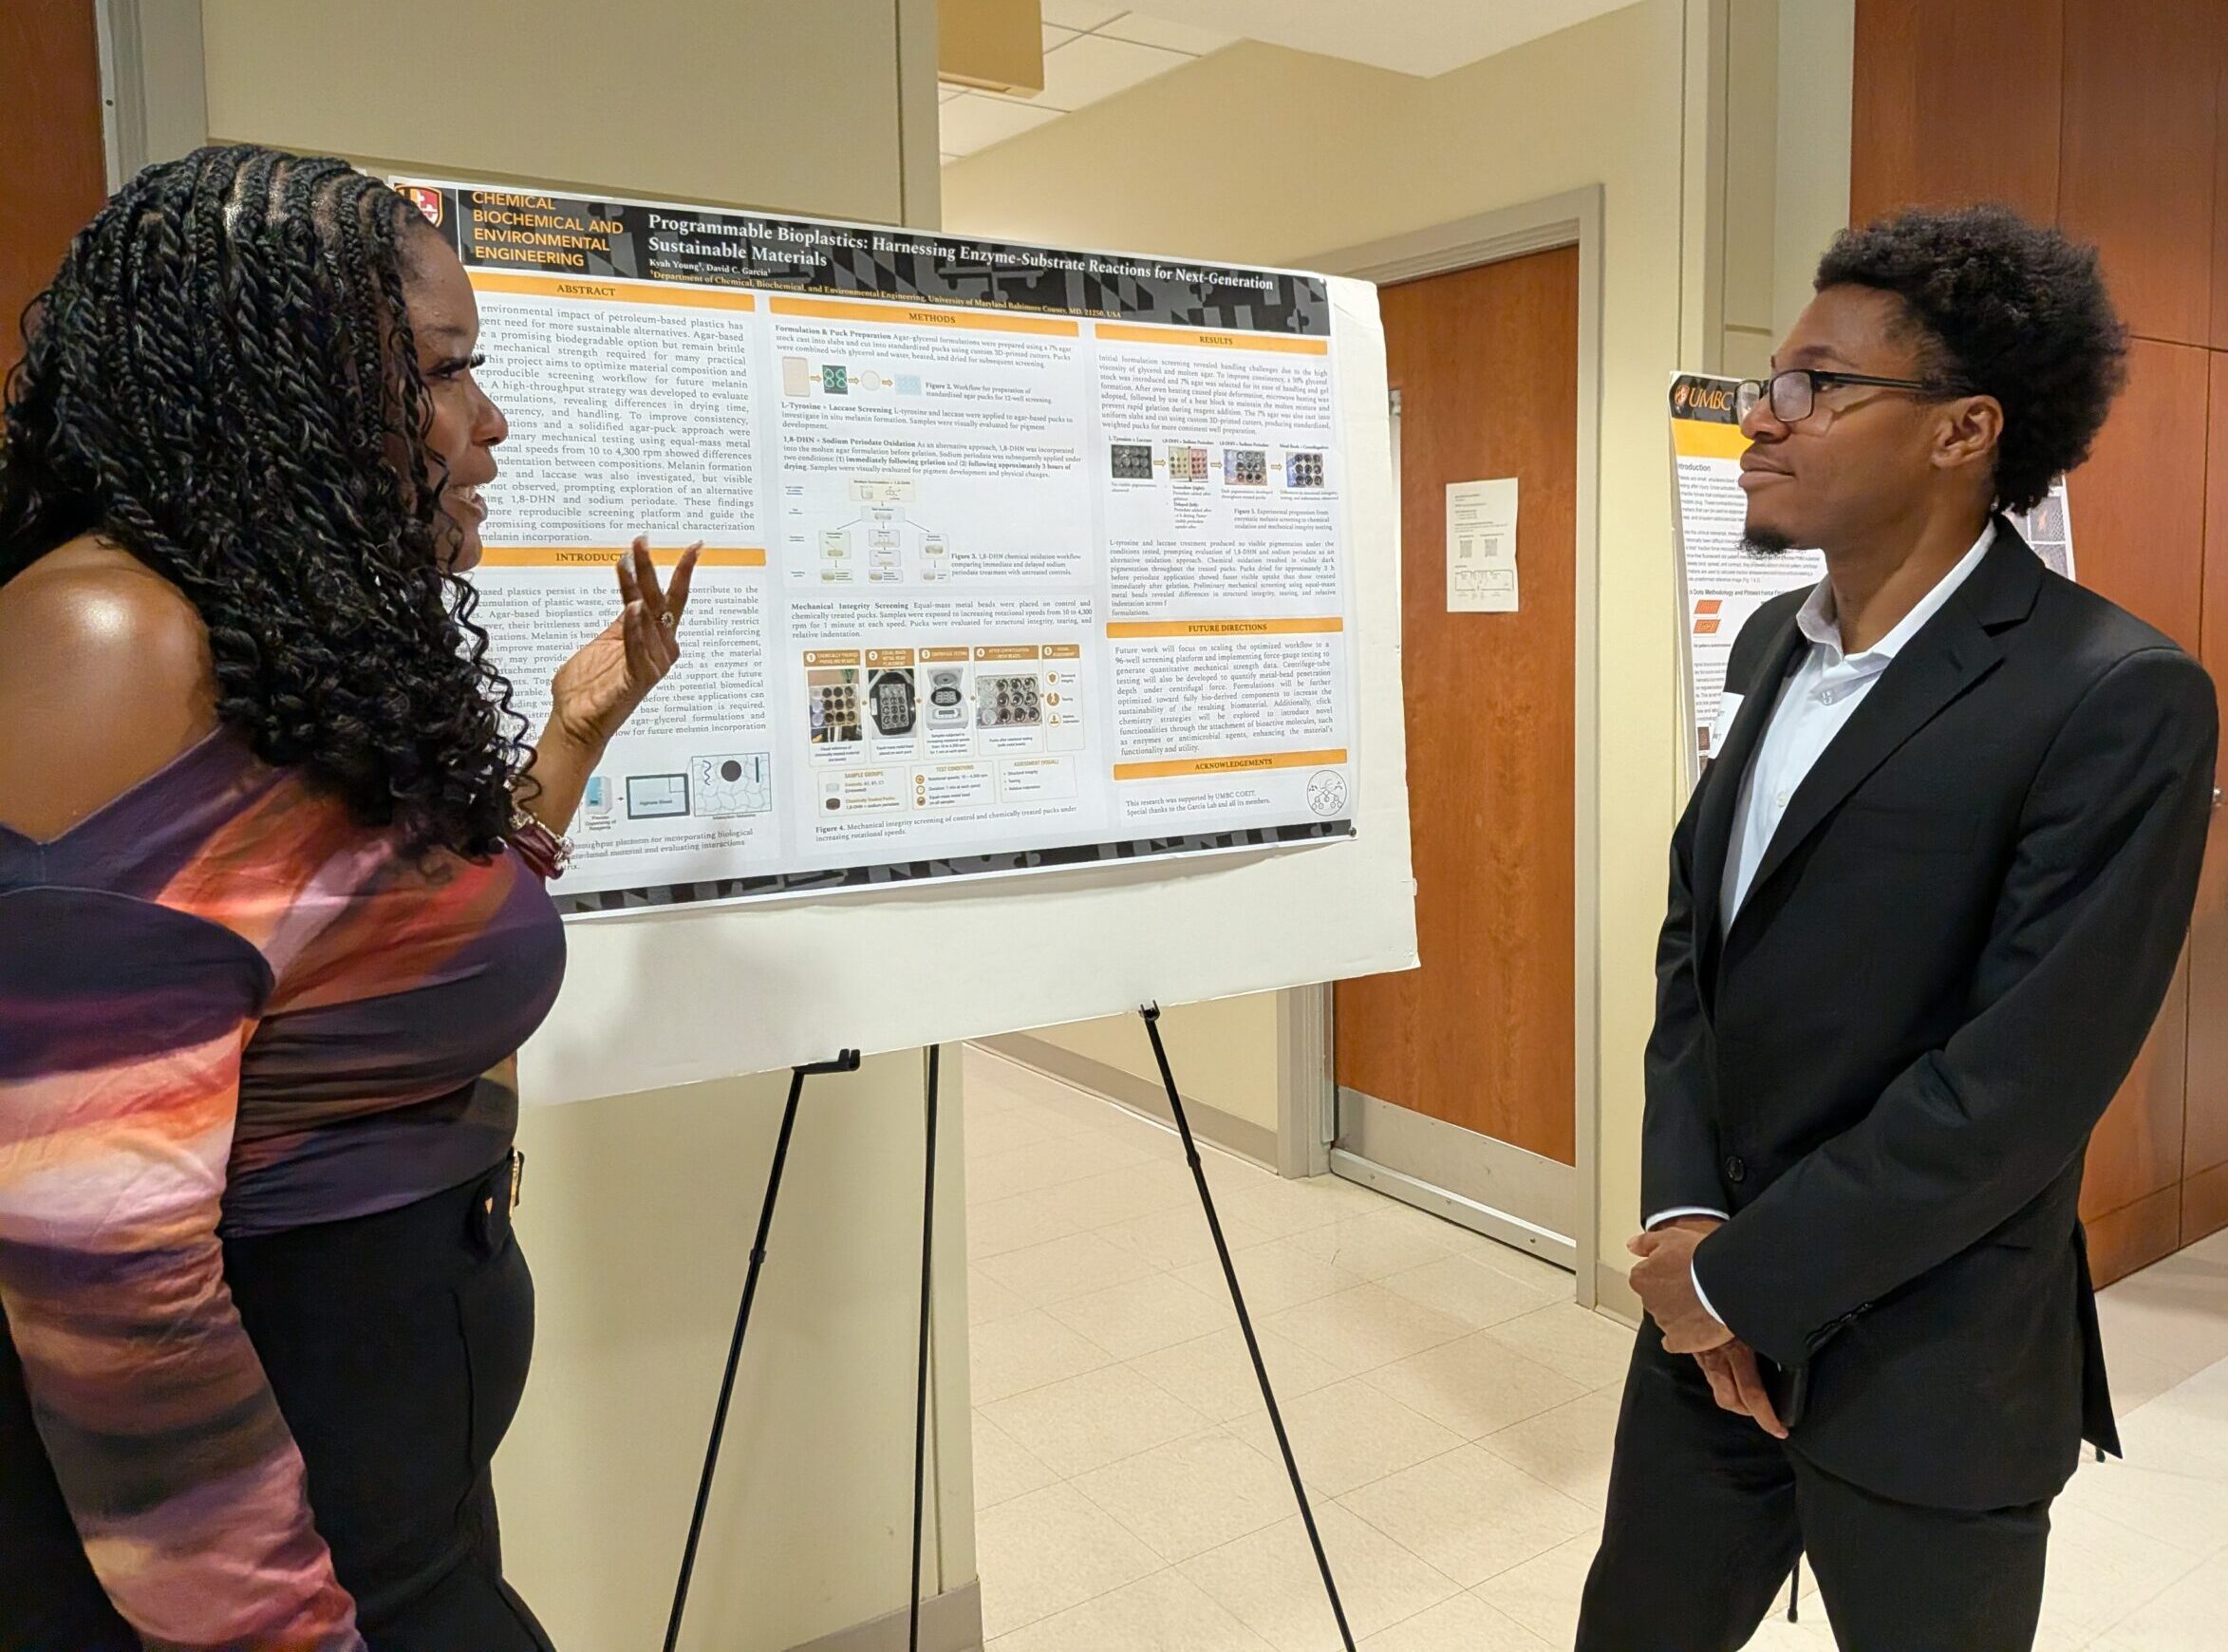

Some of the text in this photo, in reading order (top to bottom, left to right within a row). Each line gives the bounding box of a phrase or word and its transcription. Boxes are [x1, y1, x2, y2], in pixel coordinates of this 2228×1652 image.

[472, 191, 555, 209] CHEMICAL
[473, 209, 623, 234] BIOCHEMICAL AND
[474, 227, 609, 251] ENVIRONMENTAL
[475, 245, 584, 266] ENGINEERING
[648, 236, 827, 266] Sustainable Materials
[648, 214, 1273, 290] Programmable Bioplastics: Harnessing Enzyme-Substrate Reactions for Next-Generation
[648, 258, 670, 268] Kyah
[705, 263, 730, 272] David
[730, 265, 740, 273] C.
[556, 284, 615, 296] ABSTRACT
[480, 304, 743, 329] environmental impact of petroleum-based plastics has
[908, 311, 955, 323] METHODS
[503, 317, 528, 327] need
[531, 318, 546, 329] for
[549, 322, 573, 330] more
[576, 323, 630, 334] sustainable
[693, 330, 743, 342] Agar-based
[775, 324, 820, 334] Formulation
[849, 329, 891, 340] Preparation
[500, 330, 552, 343] promising
[555, 332, 623, 346] biodegradable
[627, 338, 658, 348] option
[662, 339, 677, 348] but
[682, 342, 713, 351] remain
[717, 343, 744, 353] brittle
[1199, 335, 1233, 345] RESULTS
[493, 342, 745, 366] mechanical strength required for many practical
[506, 355, 542, 366] project
[544, 357, 569, 367] aims
[583, 360, 626, 371] optimize
[628, 363, 667, 372] material
[670, 366, 727, 376] composition
[730, 368, 746, 377] and
[476, 365, 747, 388] reproducible screening workflow for future melanin
[1689, 386, 1732, 411] UMBC
[780, 401, 820, 410] L-Tyrosine
[828, 403, 856, 411] Laccase
[856, 404, 892, 415] Screening
[883, 439, 915, 447] Oxidation
[838, 602, 870, 610] Integrity
[874, 601, 908, 610] Screening
[1188, 623, 1267, 632] FUTURE DIRECTIONS
[1114, 646, 1138, 654] Future
[1140, 645, 1158, 653] work
[1177, 644, 1195, 652] focus
[1210, 643, 1233, 652] scaling
[1235, 642, 1246, 650] the
[1249, 641, 1282, 651] optimized
[1114, 655, 1140, 664] 96-well
[1141, 654, 1174, 664] screening
[1175, 653, 1203, 664] platform
[1204, 652, 1216, 661] and
[1217, 651, 1262, 662] implementing
[1263, 651, 1300, 660] force-gauge
[1301, 650, 1321, 659] testing
[1194, 758, 1272, 770] ACKNOWLEDGEMENTS
